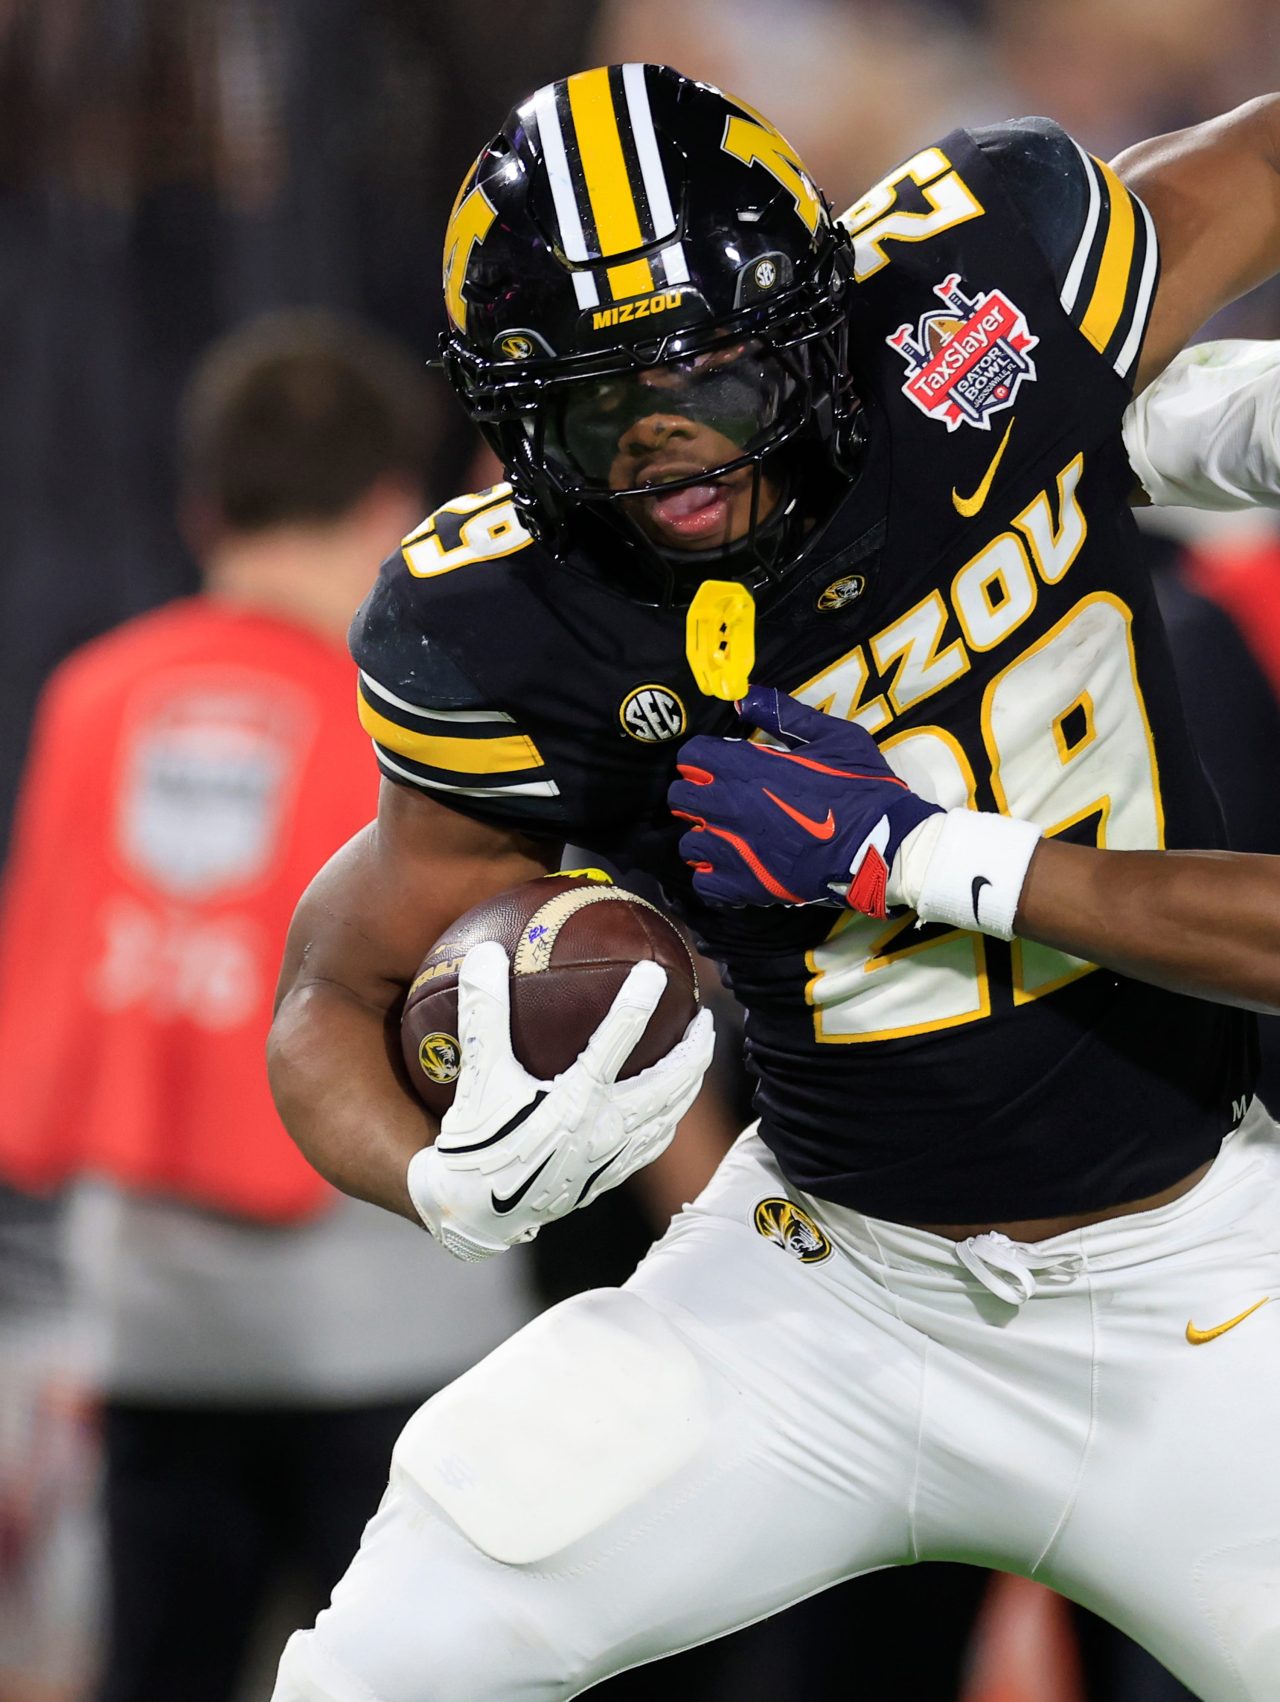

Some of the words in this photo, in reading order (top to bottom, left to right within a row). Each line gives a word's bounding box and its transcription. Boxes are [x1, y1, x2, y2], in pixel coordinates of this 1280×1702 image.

[592, 291, 682, 330] MIZZOU
[913, 306, 1005, 397] TaxSlayer
[956, 346, 1003, 393] GATOR
[964, 356, 1011, 401] BOWL
[750, 452, 1087, 752] ZZOU
[624, 689, 682, 741] SEC
[805, 591, 1166, 1044] 29
